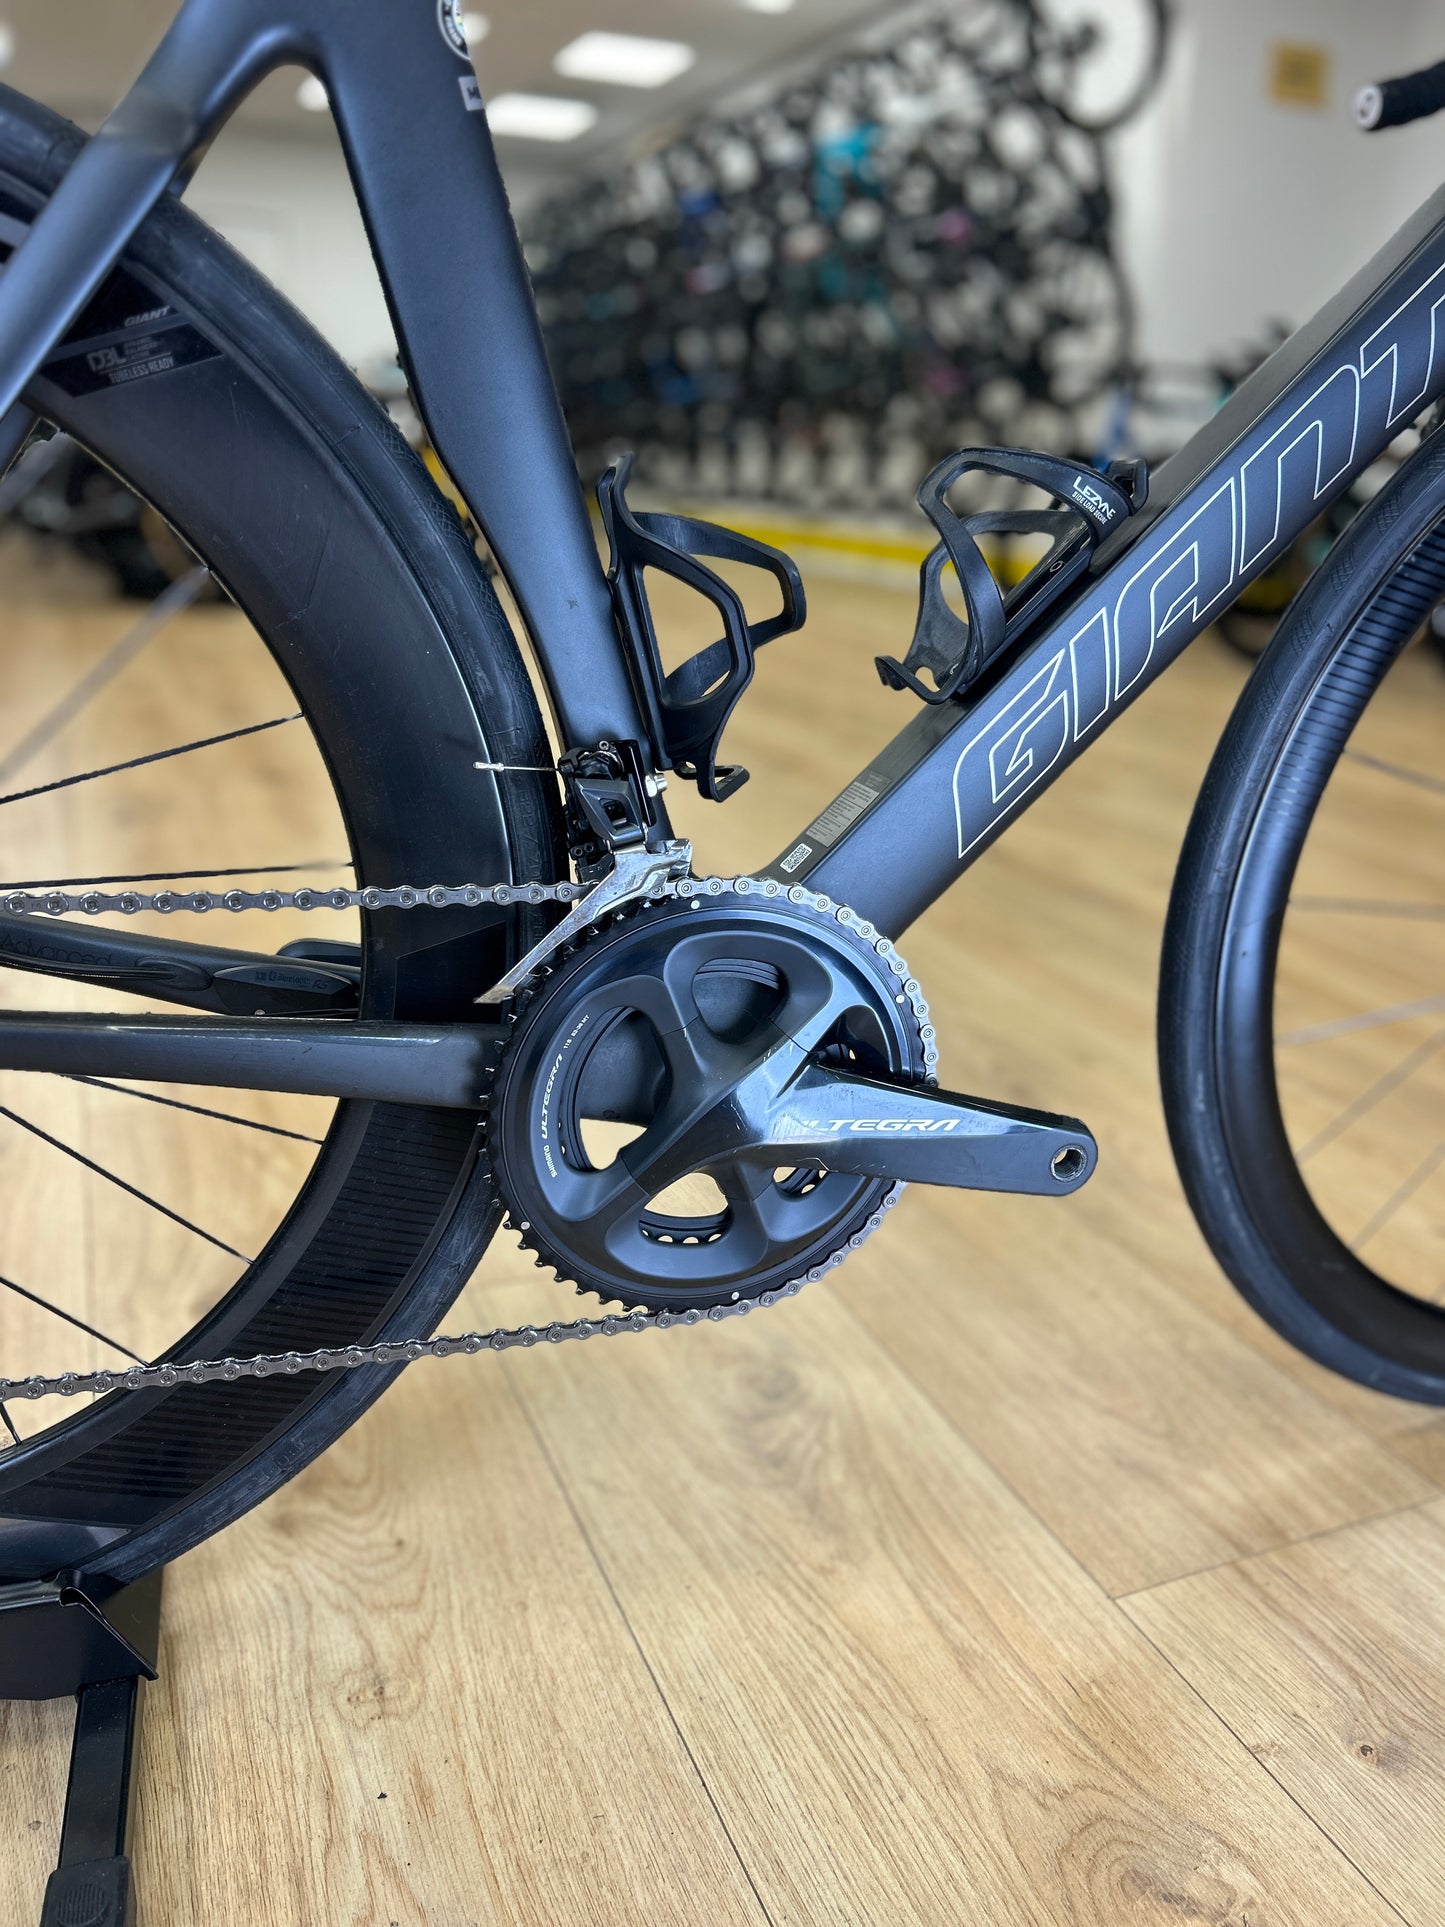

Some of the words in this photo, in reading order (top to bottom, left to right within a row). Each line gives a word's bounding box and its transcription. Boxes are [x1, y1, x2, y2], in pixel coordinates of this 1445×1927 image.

[124, 305, 171, 328] GIANT
[109, 362, 150, 384] TUBELESS
[148, 356, 174, 373] READY
[1072, 491, 1085, 503] SIDE
[1082, 499, 1096, 513] LOAD
[1073, 475, 1116, 520] LEZYNE
[953, 263, 1445, 858] GIANT
[541, 1053, 563, 1140] ULTEGRA
[543, 1144, 558, 1178] SHIMANO
